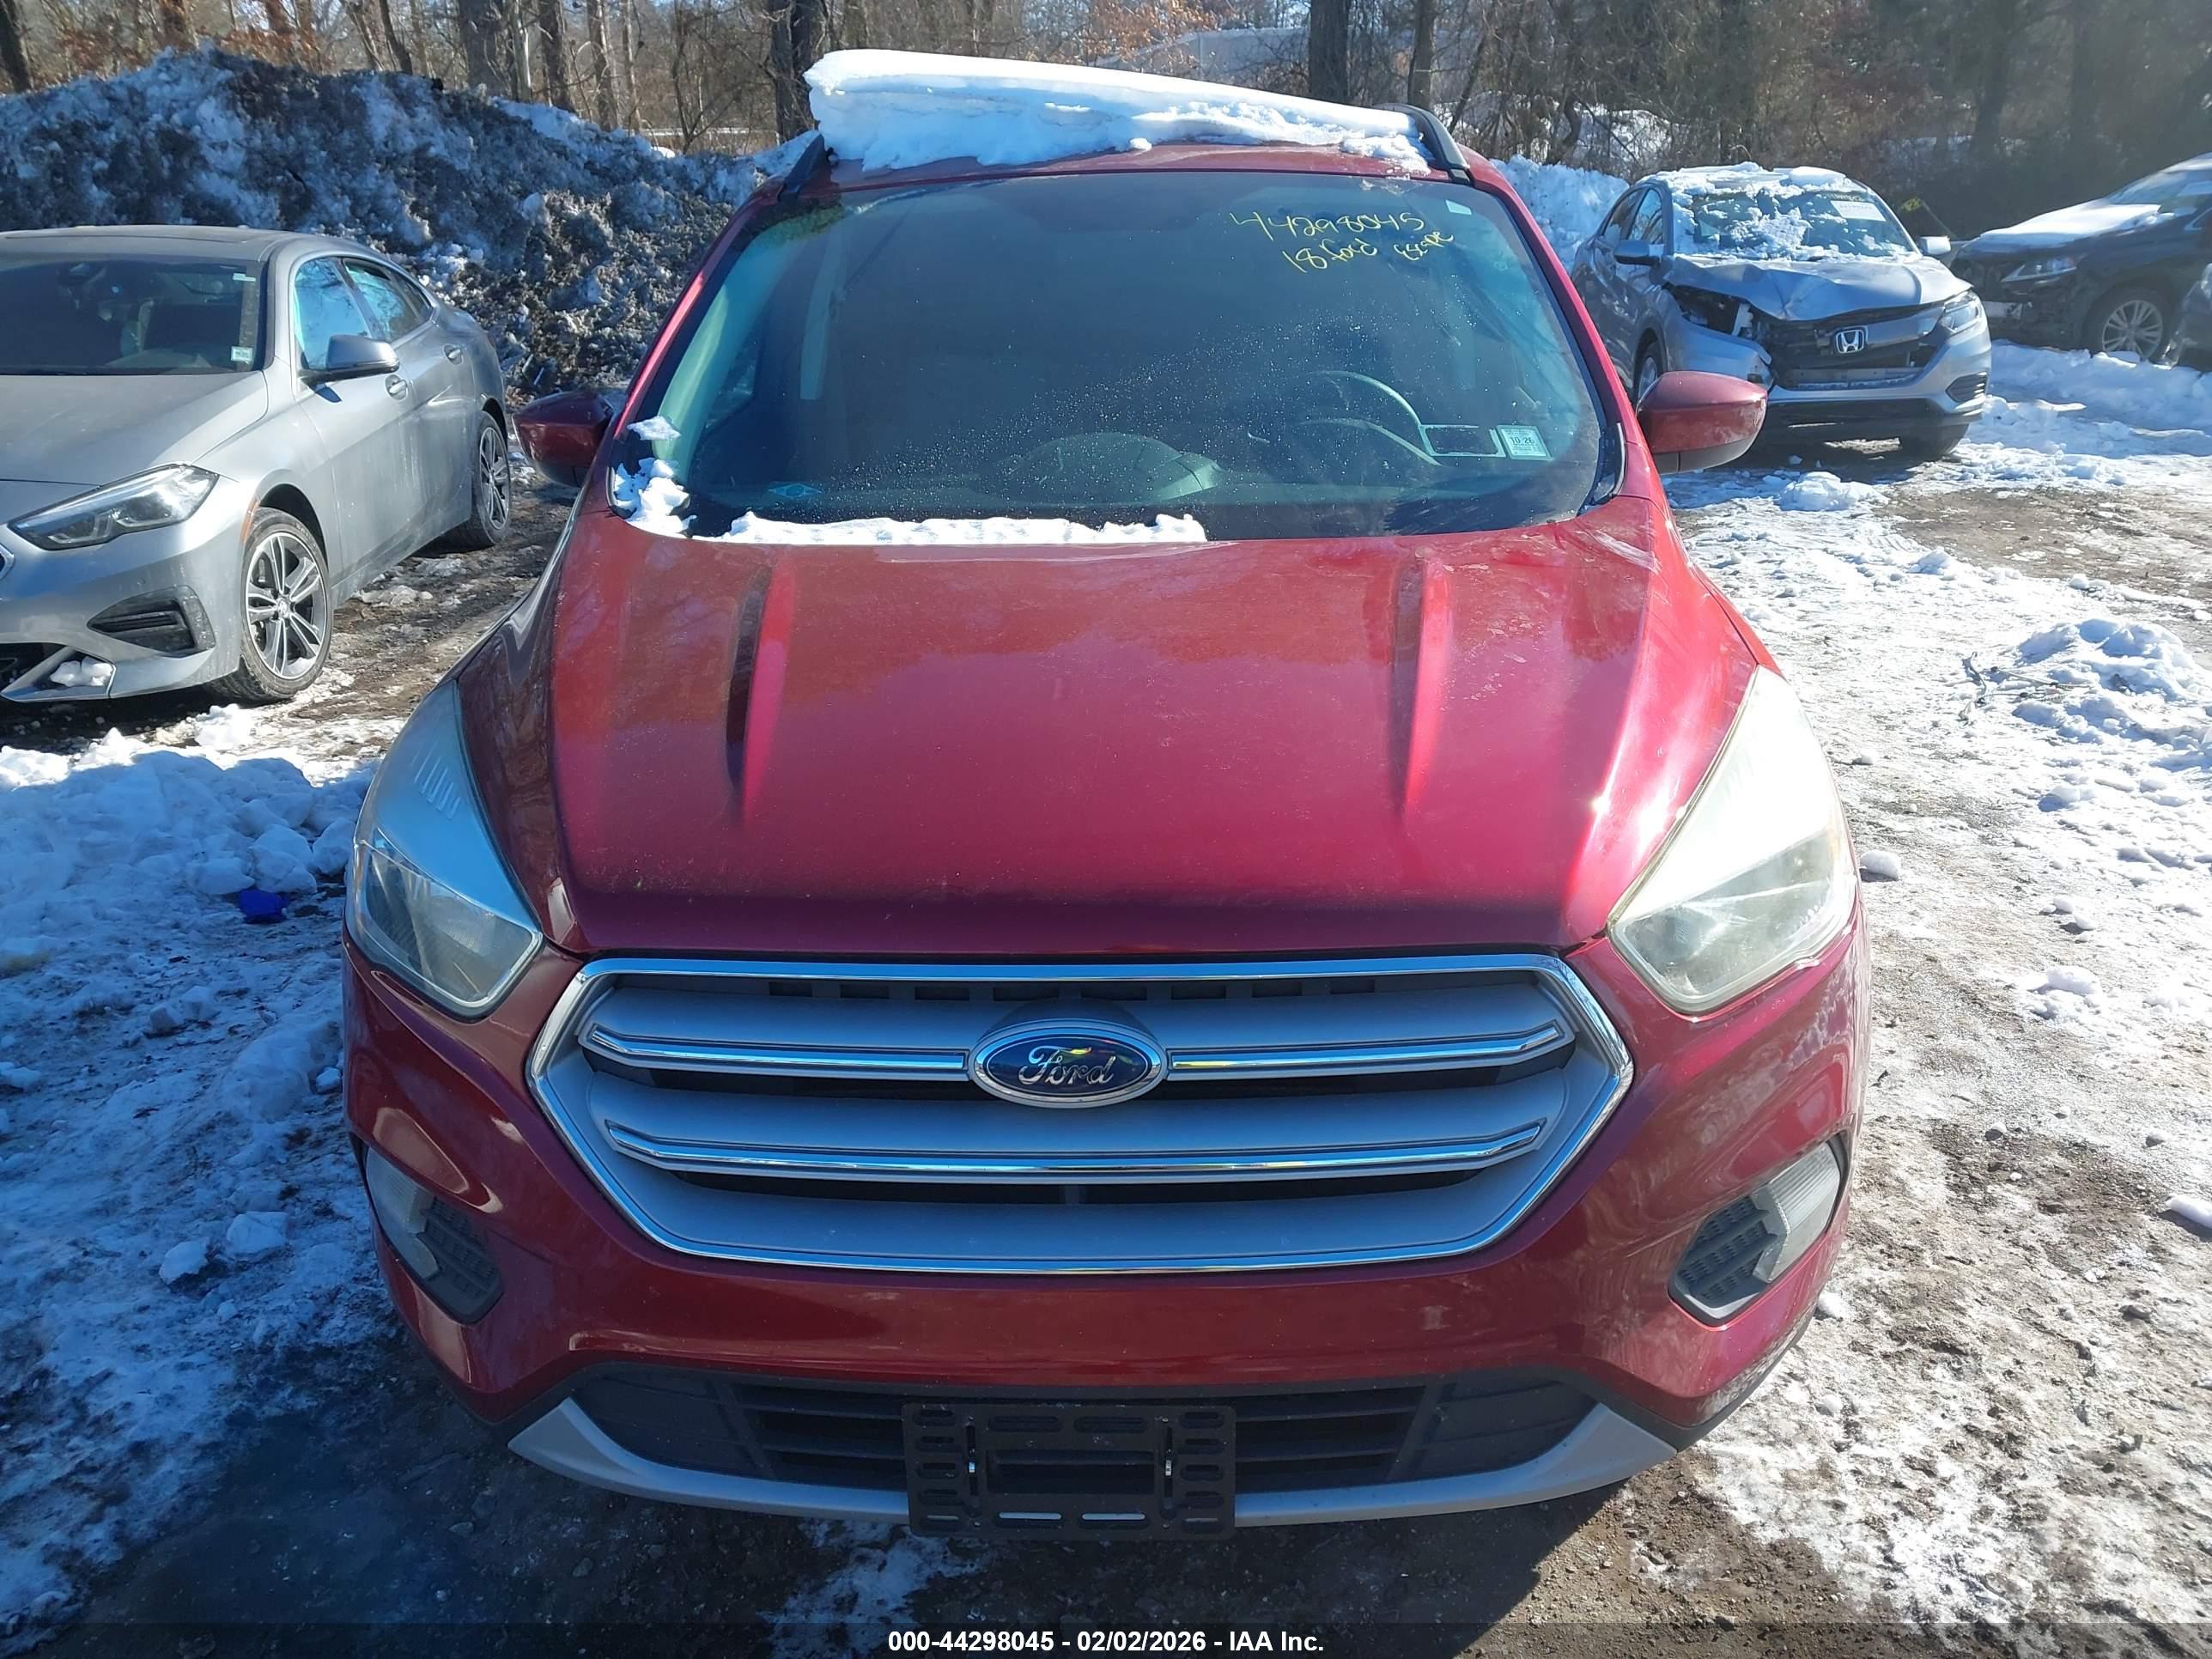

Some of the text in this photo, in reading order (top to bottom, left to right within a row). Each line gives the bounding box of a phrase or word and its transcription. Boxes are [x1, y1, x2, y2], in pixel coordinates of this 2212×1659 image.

[1229, 211, 1425, 241] 44298045
[1282, 246, 1328, 274] 18
[1018, 1044, 1117, 1085] Ford
